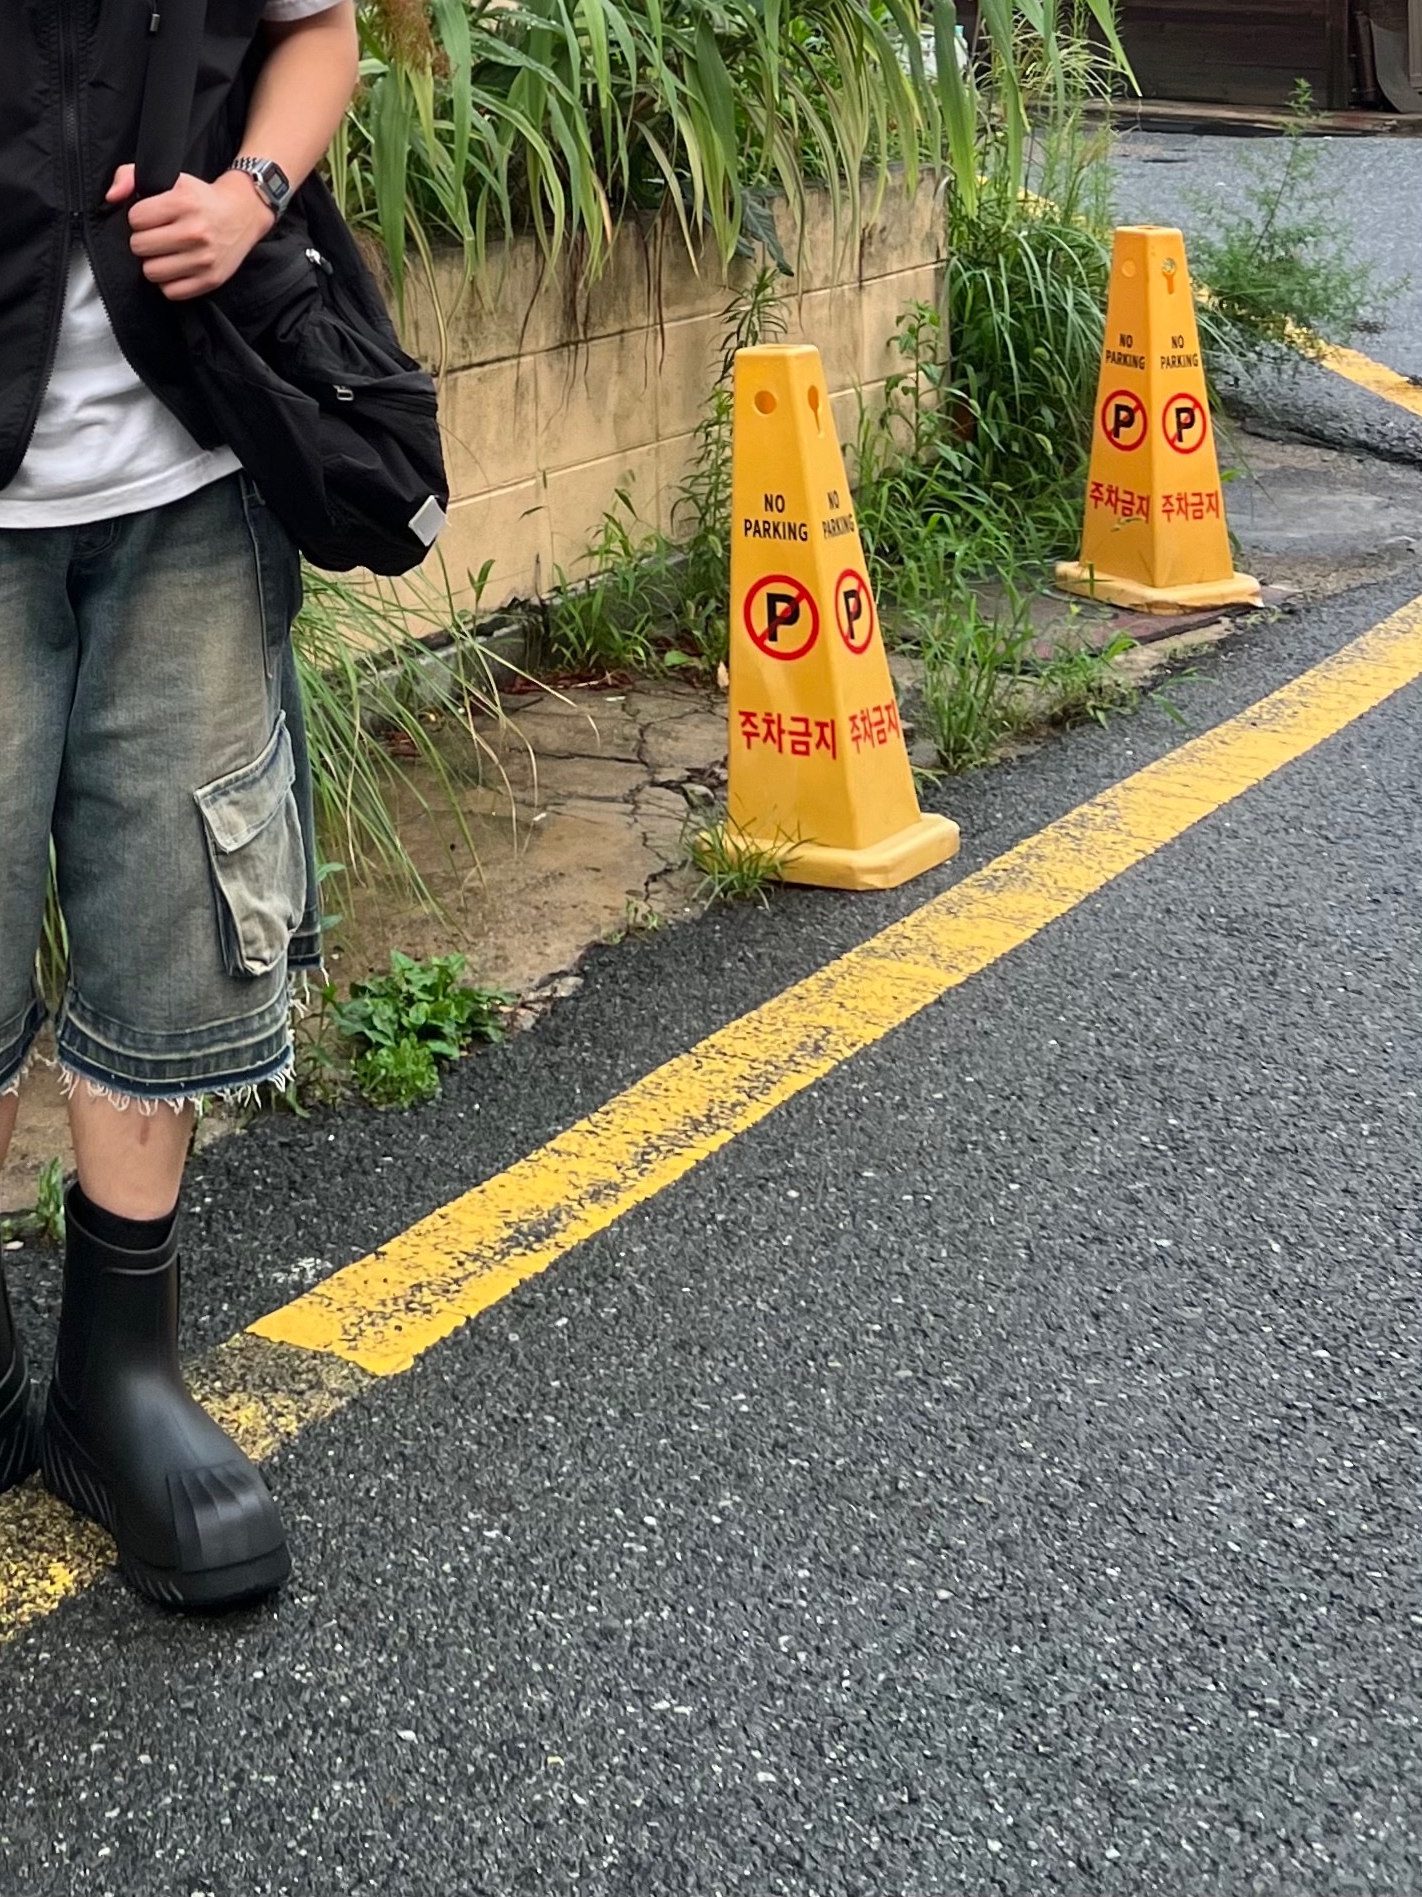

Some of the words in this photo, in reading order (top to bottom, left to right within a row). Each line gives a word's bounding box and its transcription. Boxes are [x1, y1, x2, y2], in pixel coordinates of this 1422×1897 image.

[1119, 333, 1133, 348] NO
[1171, 335, 1184, 349] NO
[1105, 350, 1146, 370] PARKING
[1160, 353, 1199, 370] PARKING
[764, 493, 785, 513] NO
[827, 489, 840, 510] NO
[1089, 480, 1150, 524] 주차금지
[1161, 489, 1220, 522] 주차금지
[743, 519, 808, 542] PARKING
[822, 513, 855, 540] PARKING
[738, 709, 838, 760] 주차금지
[849, 698, 900, 755] 주차금지
